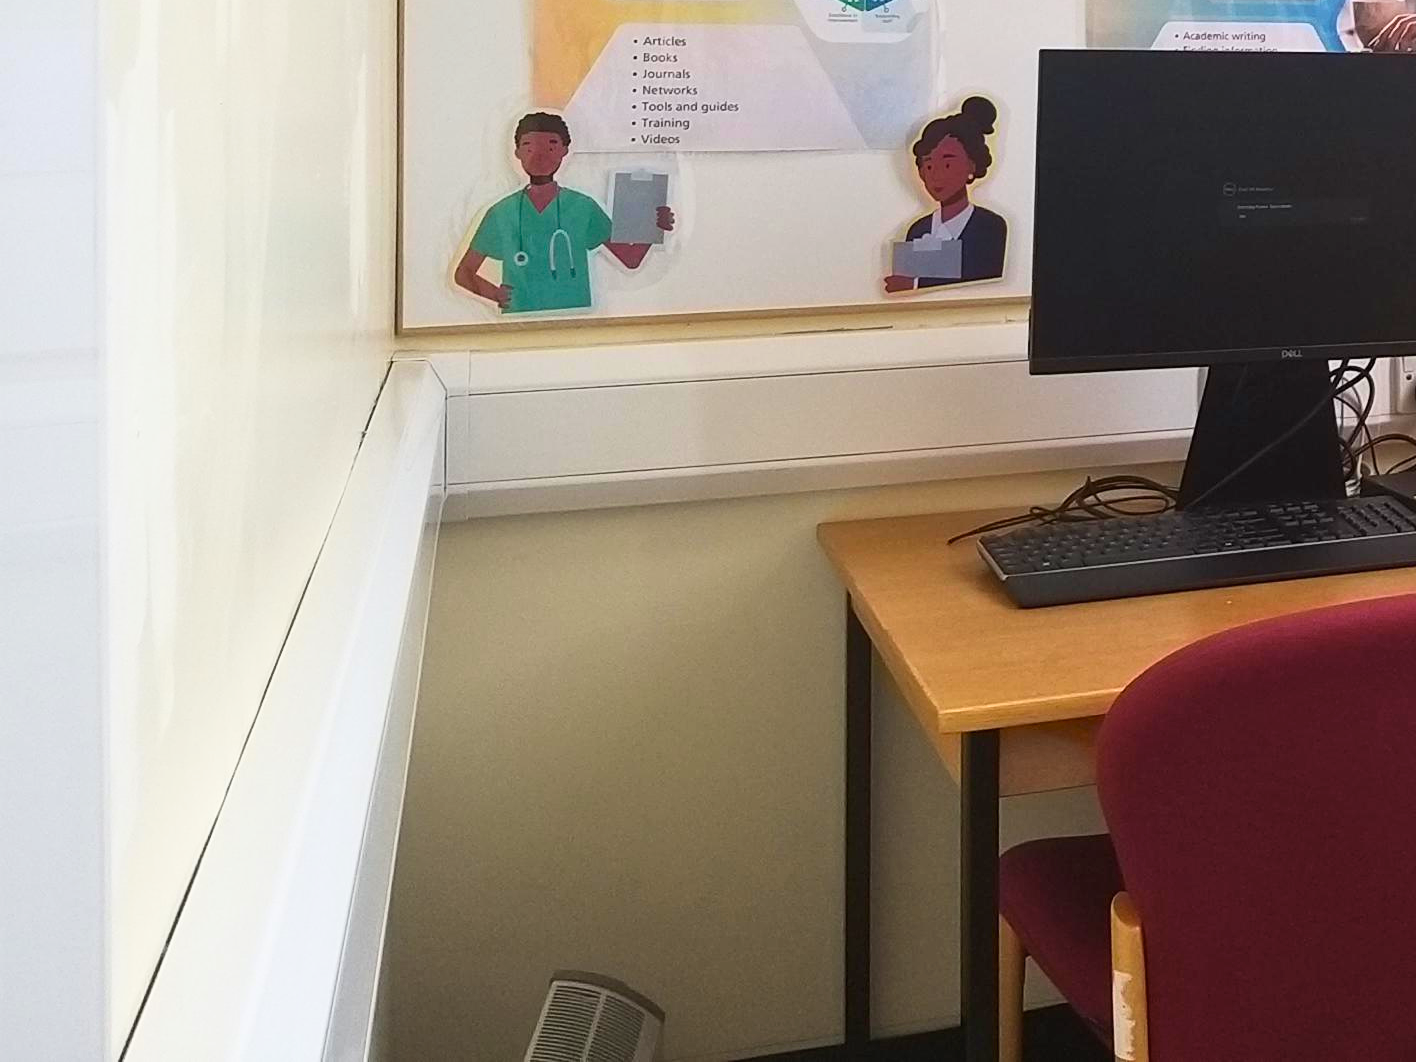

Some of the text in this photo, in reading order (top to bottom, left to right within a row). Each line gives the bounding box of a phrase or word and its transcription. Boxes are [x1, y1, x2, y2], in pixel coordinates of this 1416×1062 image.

[643, 37, 686, 46] Articles
[1183, 32, 1265, 42] Academic writing
[643, 53, 678, 62] Books
[643, 69, 690, 79] Journals
[643, 86, 697, 95] Networks
[642, 101, 739, 114] Tools and guides
[641, 118, 690, 130] Training
[641, 134, 680, 144] Videos
